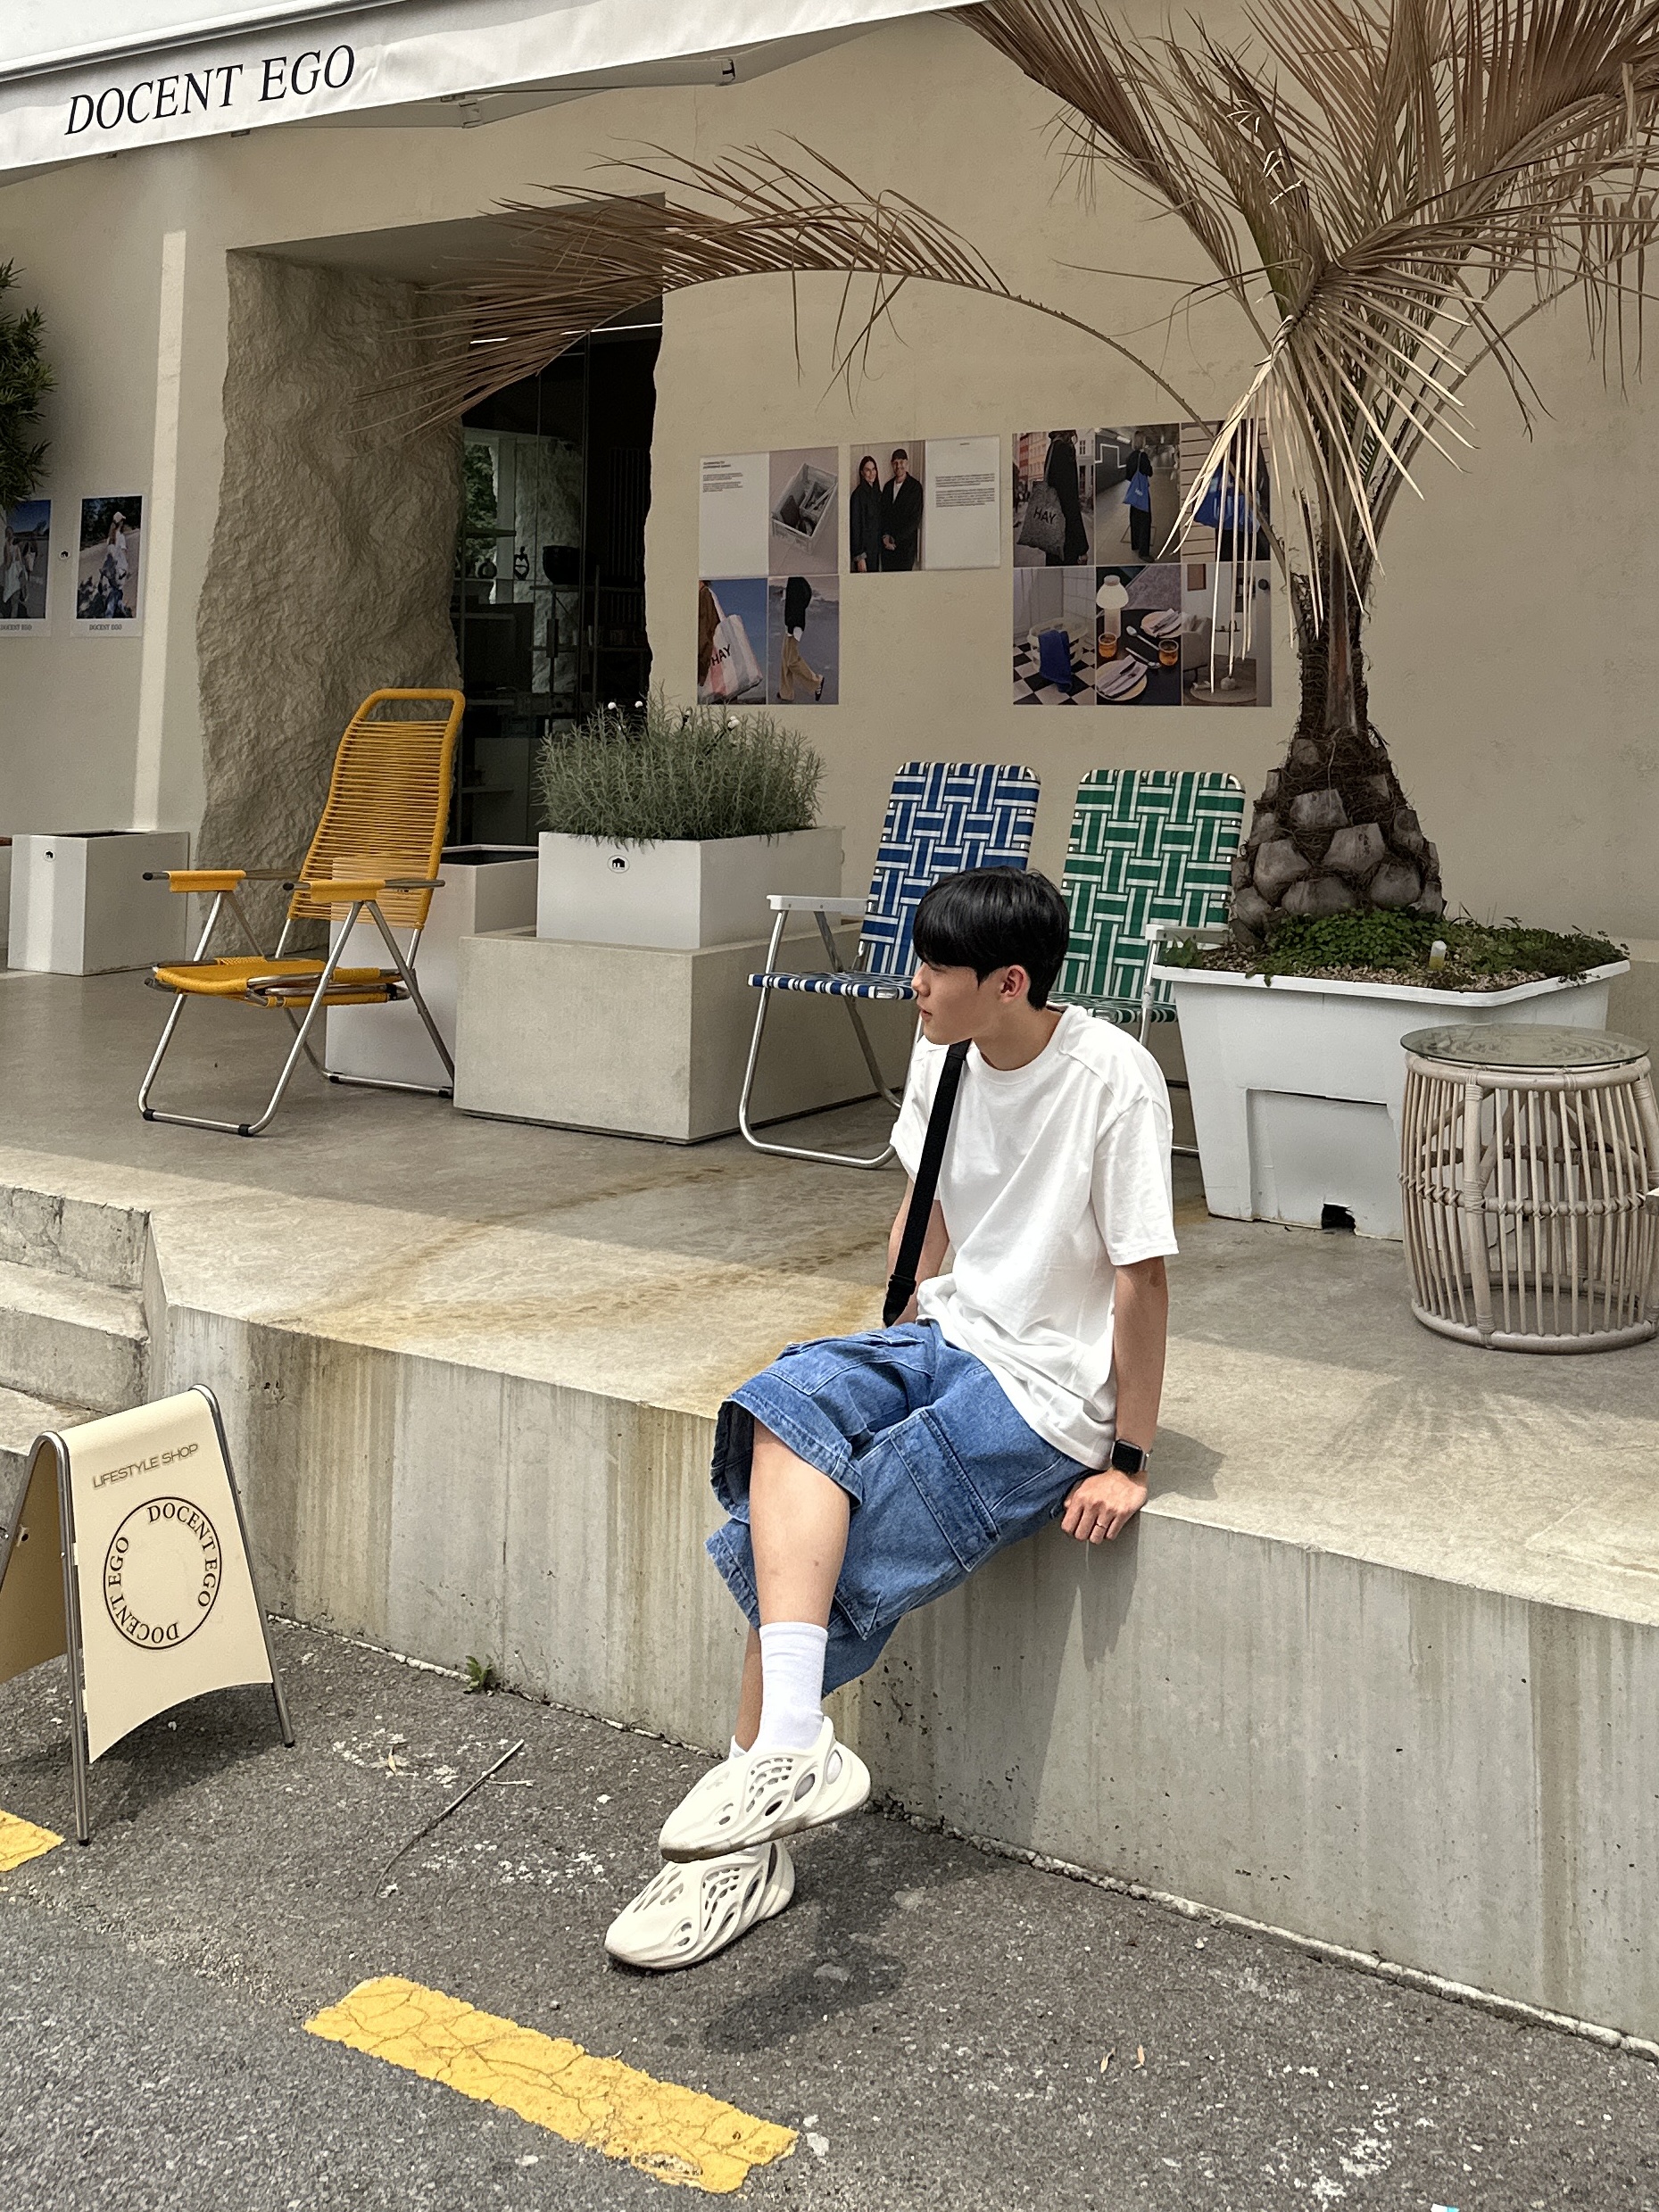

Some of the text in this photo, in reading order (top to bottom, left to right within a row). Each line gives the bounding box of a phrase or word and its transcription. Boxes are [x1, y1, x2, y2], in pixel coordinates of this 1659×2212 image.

[64, 45, 356, 136] DOCENT EGO
[1033, 507, 1056, 525] HAY
[711, 643, 731, 666] HAY
[93, 1443, 198, 1488] LIFESTYLE SHOP
[147, 1502, 219, 1607] DOCENT EGO
[108, 1537, 180, 1643] DOCENT EGO
